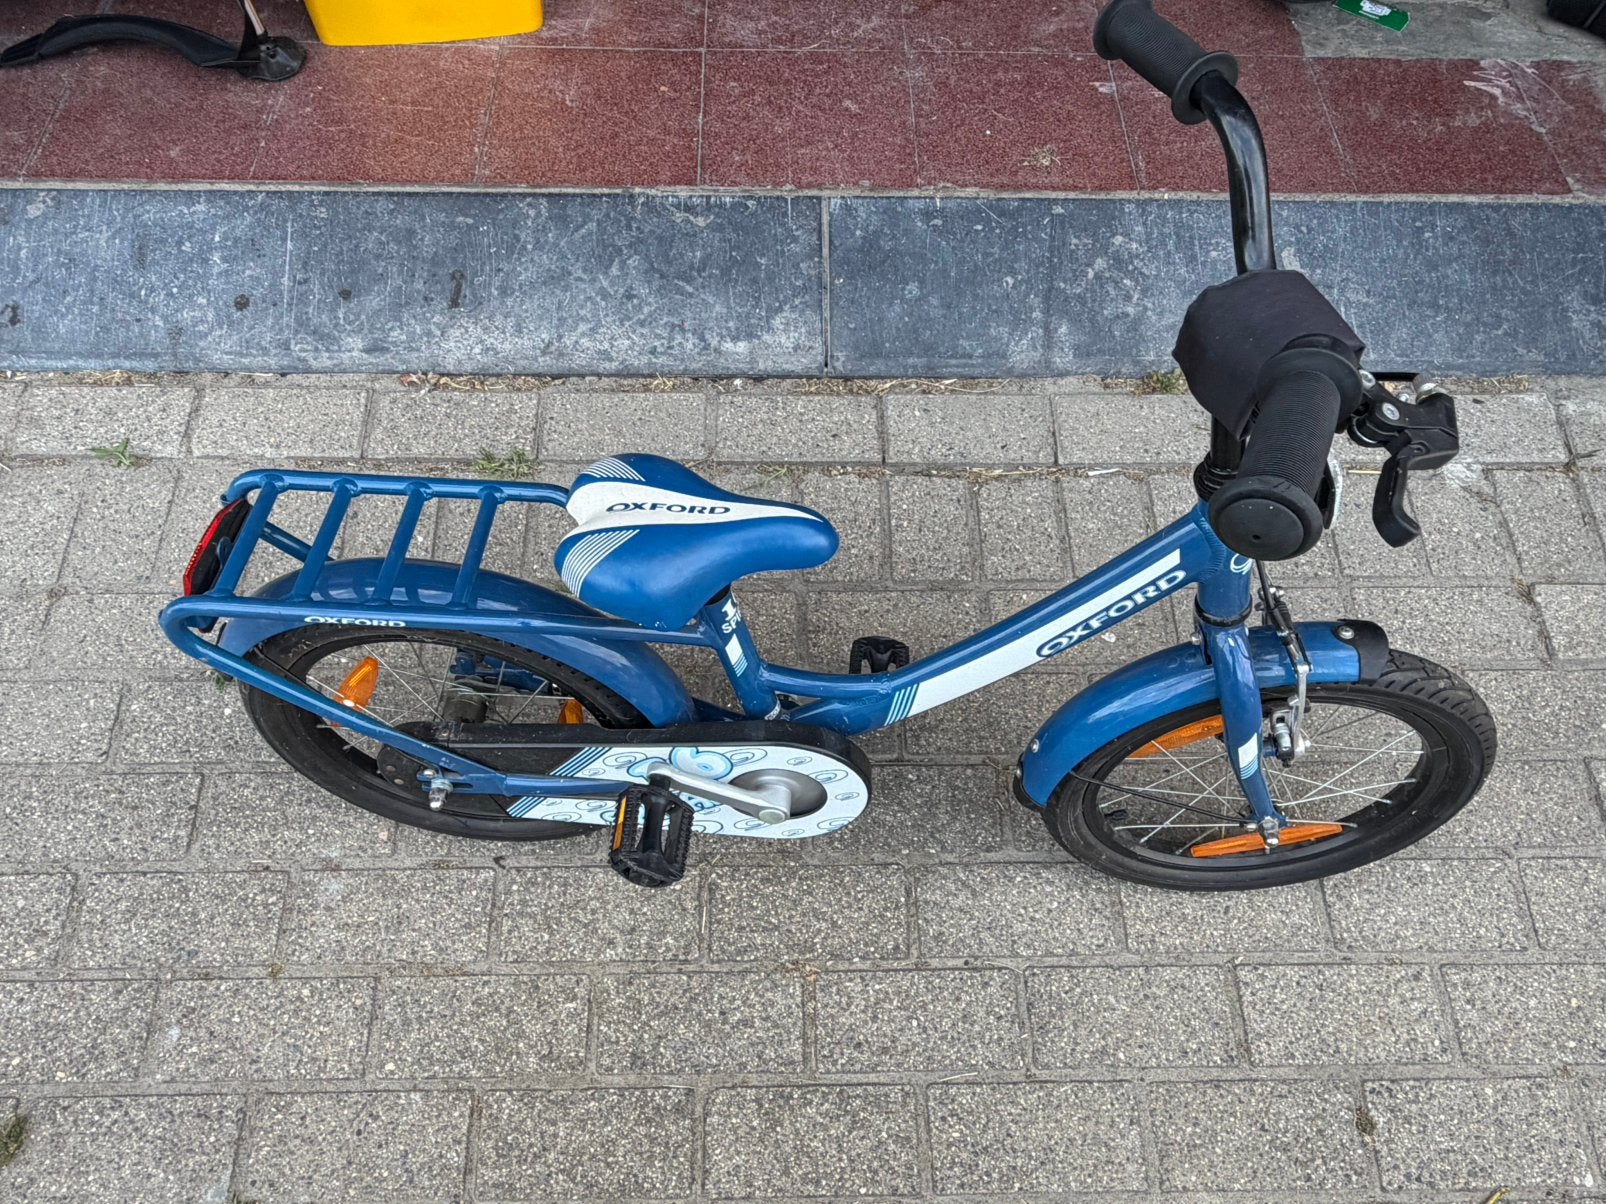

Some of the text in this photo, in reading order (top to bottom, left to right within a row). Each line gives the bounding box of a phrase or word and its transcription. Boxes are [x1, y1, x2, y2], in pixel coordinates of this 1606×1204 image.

[606, 503, 730, 514] OXFORD
[1040, 570, 1186, 656] OXFORD
[304, 616, 405, 627] OXFORD
